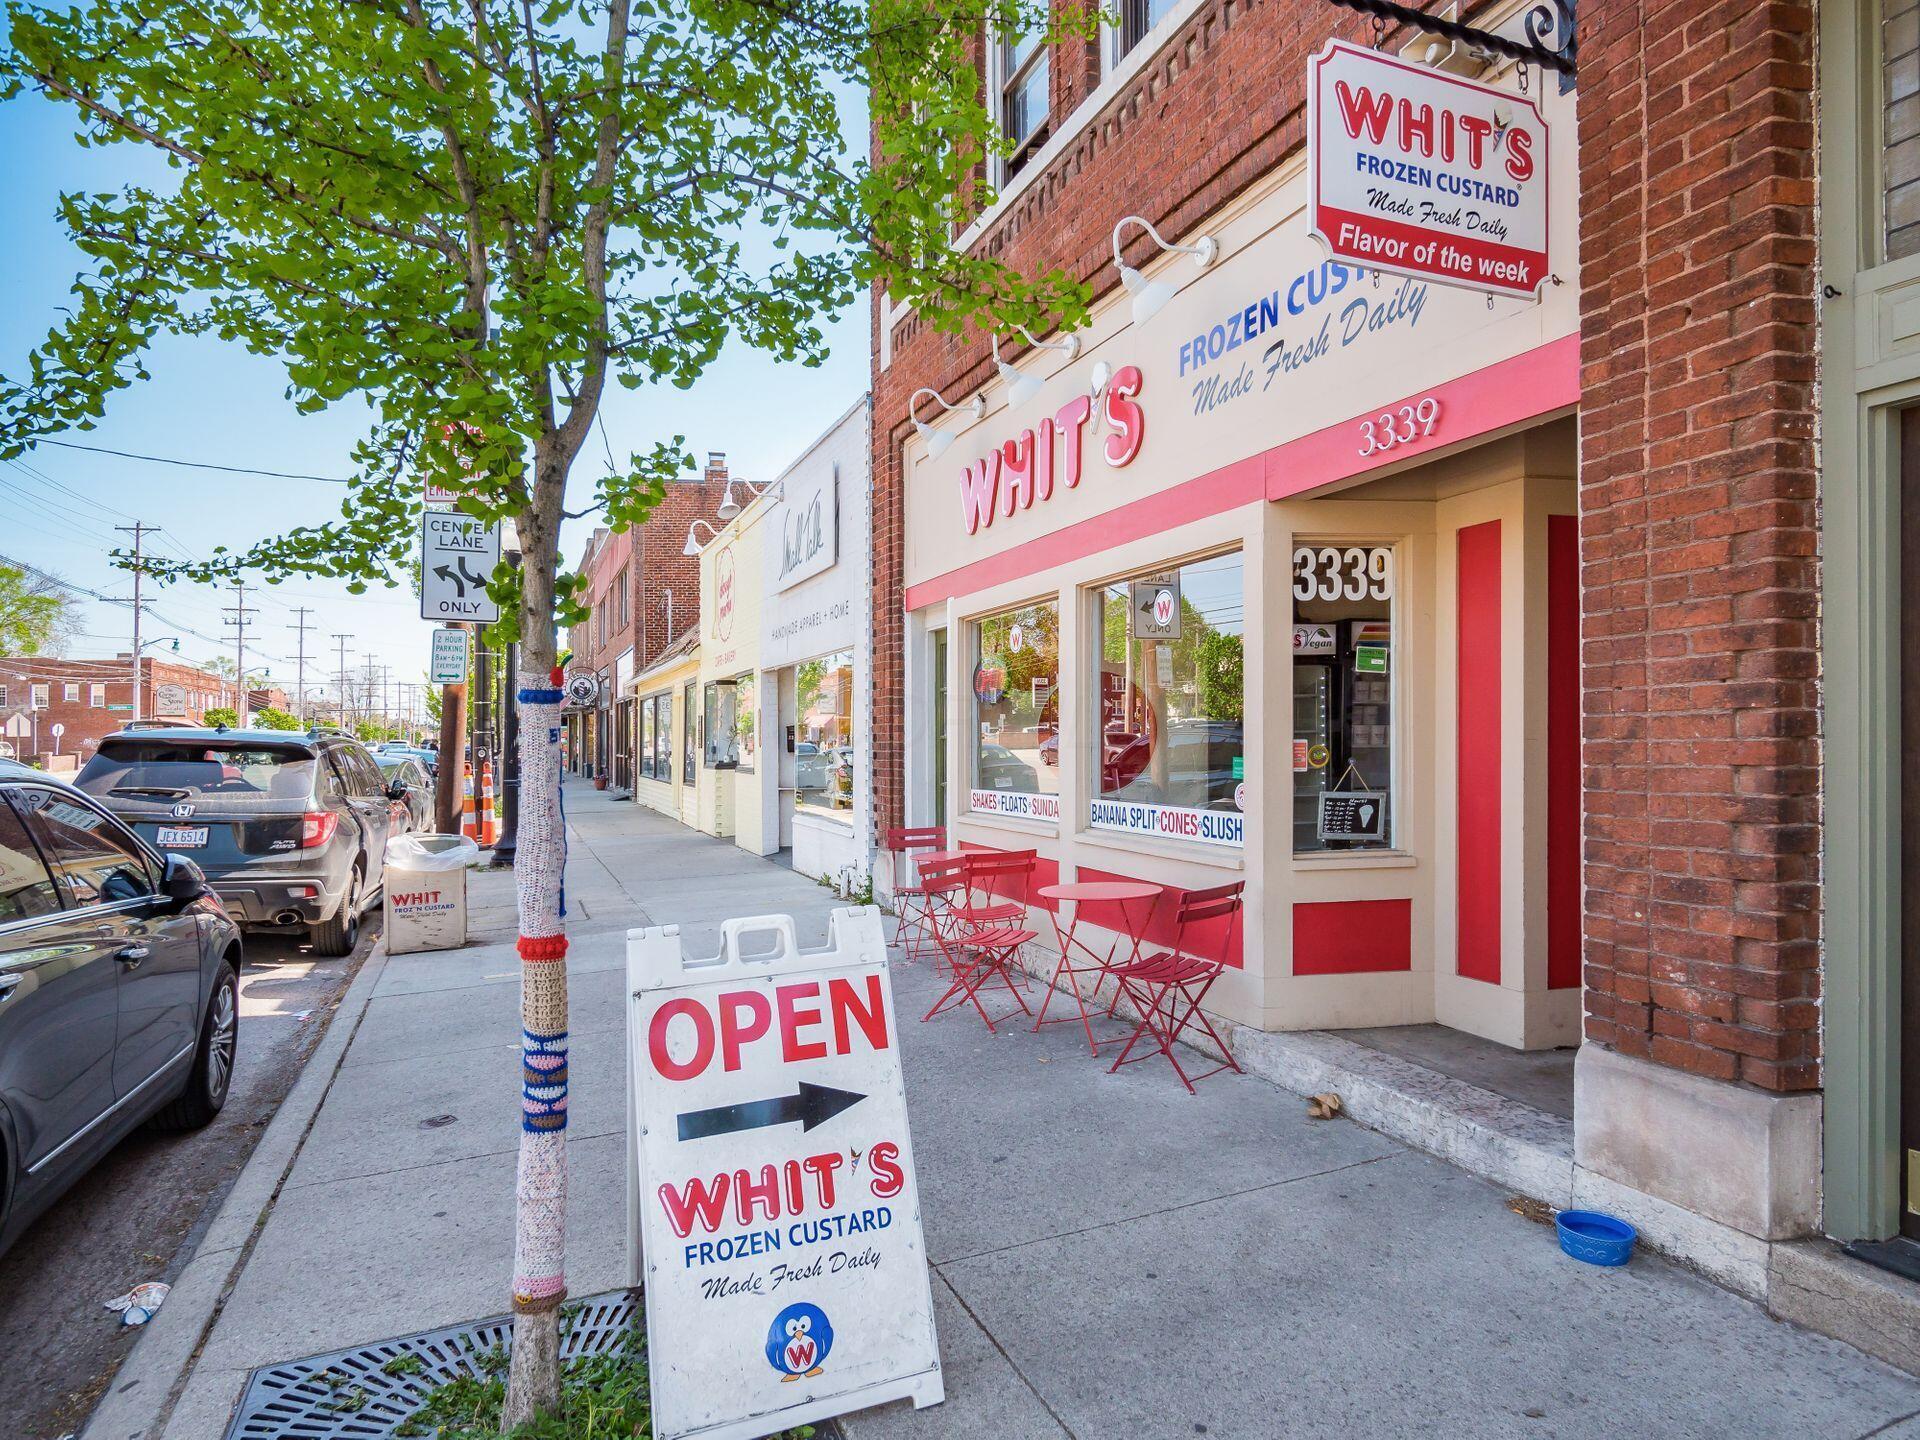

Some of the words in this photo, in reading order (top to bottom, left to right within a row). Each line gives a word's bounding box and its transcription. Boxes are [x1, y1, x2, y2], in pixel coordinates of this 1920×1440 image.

[1335, 80, 1533, 182] WHIT'S
[1356, 152, 1431, 188] FROZEN
[1436, 173, 1519, 207] CUSTARD
[1367, 188, 1414, 216] Made
[1419, 201, 1461, 227] Fresh
[1466, 211, 1508, 242] Daily
[1338, 222, 1409, 259] Flavor
[1413, 241, 1437, 265] of
[1440, 246, 1472, 272] the
[1478, 257, 1529, 283] week
[1179, 290, 1278, 379] FROZEN
[1191, 361, 1253, 416] Made
[1262, 312, 1331, 392] Fresh
[1340, 278, 1428, 347] Daily
[1359, 397, 1441, 458] 3339
[959, 361, 1144, 536] WHIT'S
[431, 520, 493, 535] CENER
[440, 535, 483, 548] LANE
[1293, 547, 1393, 602] 3339
[440, 601, 481, 614] ONLY
[772, 619, 798, 641] HANDMADE
[800, 611, 822, 632] APPAREL
[829, 600, 849, 620] HOME
[1158, 599, 1171, 620] W
[437, 635, 442, 643] 2
[1011, 630, 1022, 648] W
[1297, 628, 1332, 649] Vegan
[971, 791, 997, 810] SHAKES
[1001, 795, 1028, 814] FLOATS
[1091, 803, 1128, 826] BANANA
[1130, 806, 1157, 831] SPLIT
[1160, 810, 1198, 836] CONES
[1202, 815, 1243, 842] SLUSH
[160, 831, 178, 842] JEX
[181, 831, 204, 842] 6514
[391, 891, 441, 907] WHIT
[424, 903, 455, 911] CUSTARD
[649, 975, 889, 1081] OPEN
[658, 1142, 904, 1238] WHIT'S
[684, 1228, 781, 1268] FROZEN
[789, 1207, 892, 1246] CUSTARD
[701, 1272, 764, 1300] Made
[769, 1254, 823, 1291] Fresh
[829, 1247, 883, 1274] Daily
[787, 1342, 814, 1368] W
